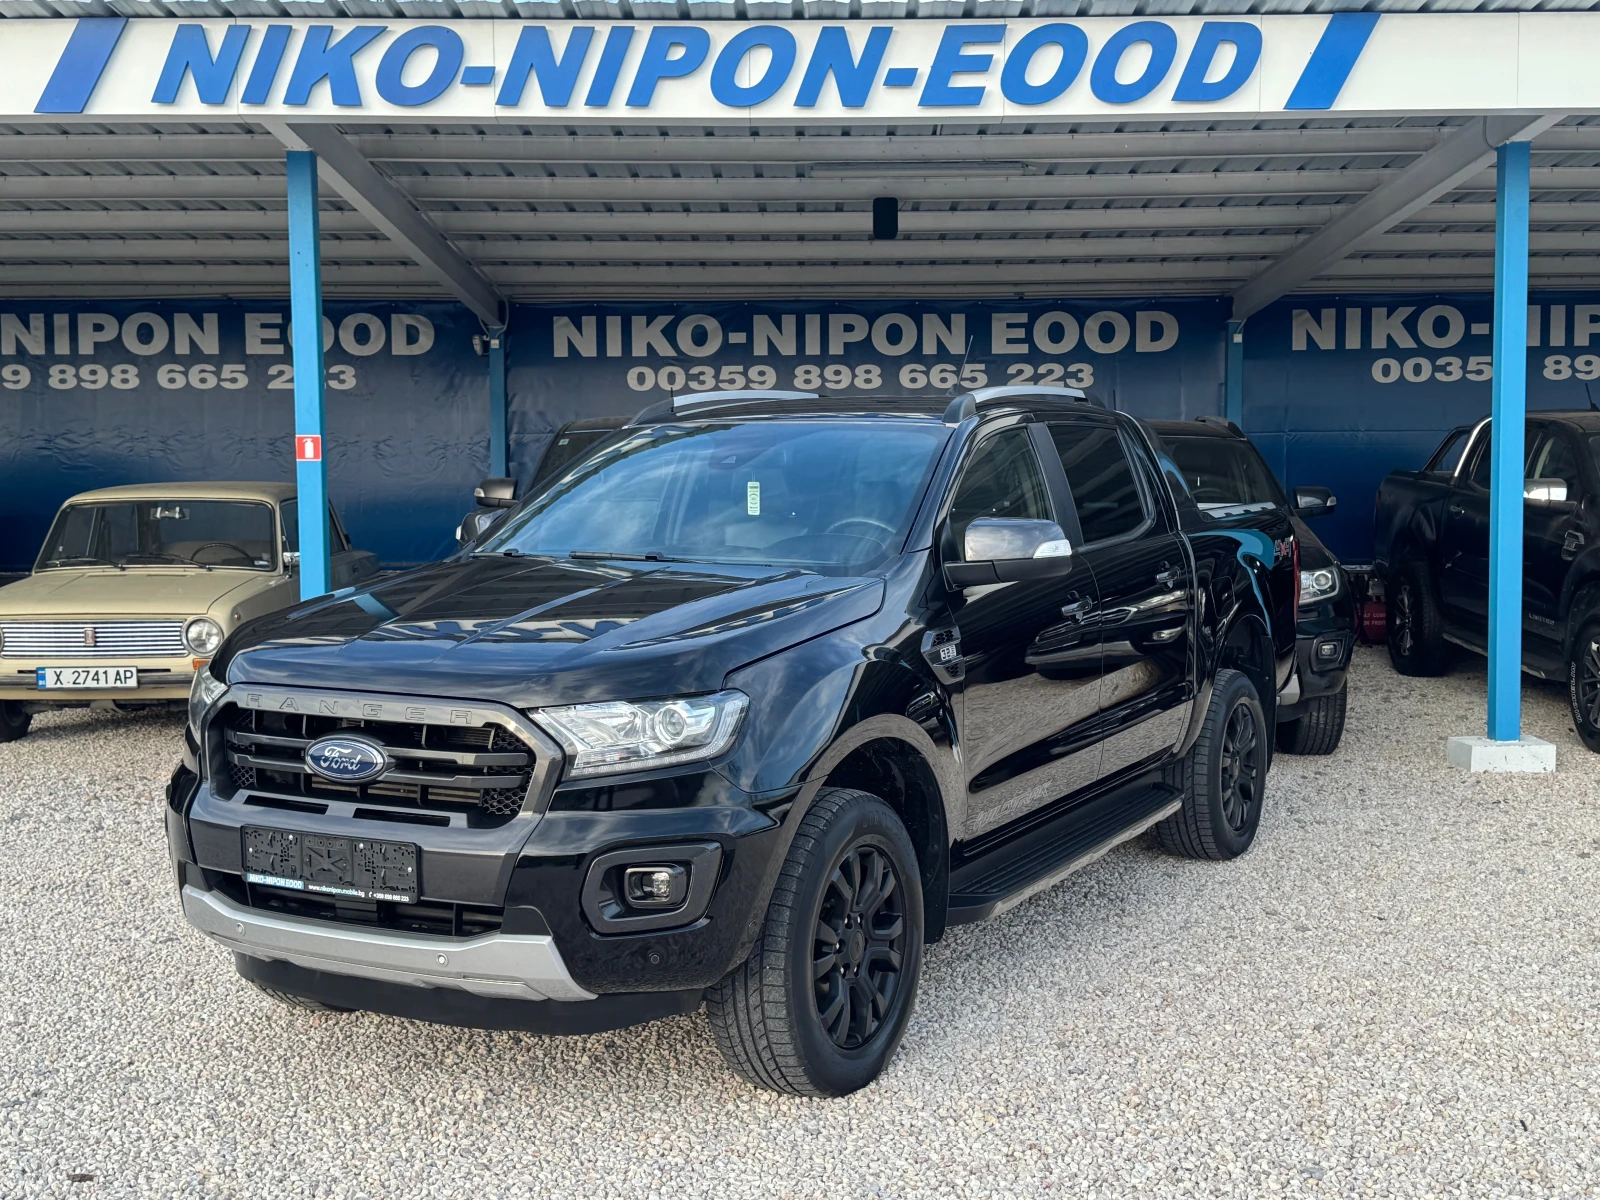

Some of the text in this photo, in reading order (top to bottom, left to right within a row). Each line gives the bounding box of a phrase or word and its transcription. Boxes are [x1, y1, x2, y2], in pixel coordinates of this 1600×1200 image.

[151, 21, 1263, 107] NIKO-NIPON-EOOD
[0, 312, 220, 356] NIPON
[553, 311, 1180, 357] NIKO-NIPON EOOD
[1, 364, 357, 389] 9 898 665 23
[627, 363, 1095, 391] 00359 898 665 223
[53, 670, 134, 685] X 2741 AP
[245, 693, 473, 725] RANGER
[320, 745, 361, 772] Ford
[249, 873, 286, 886] NIKO-NIPON
